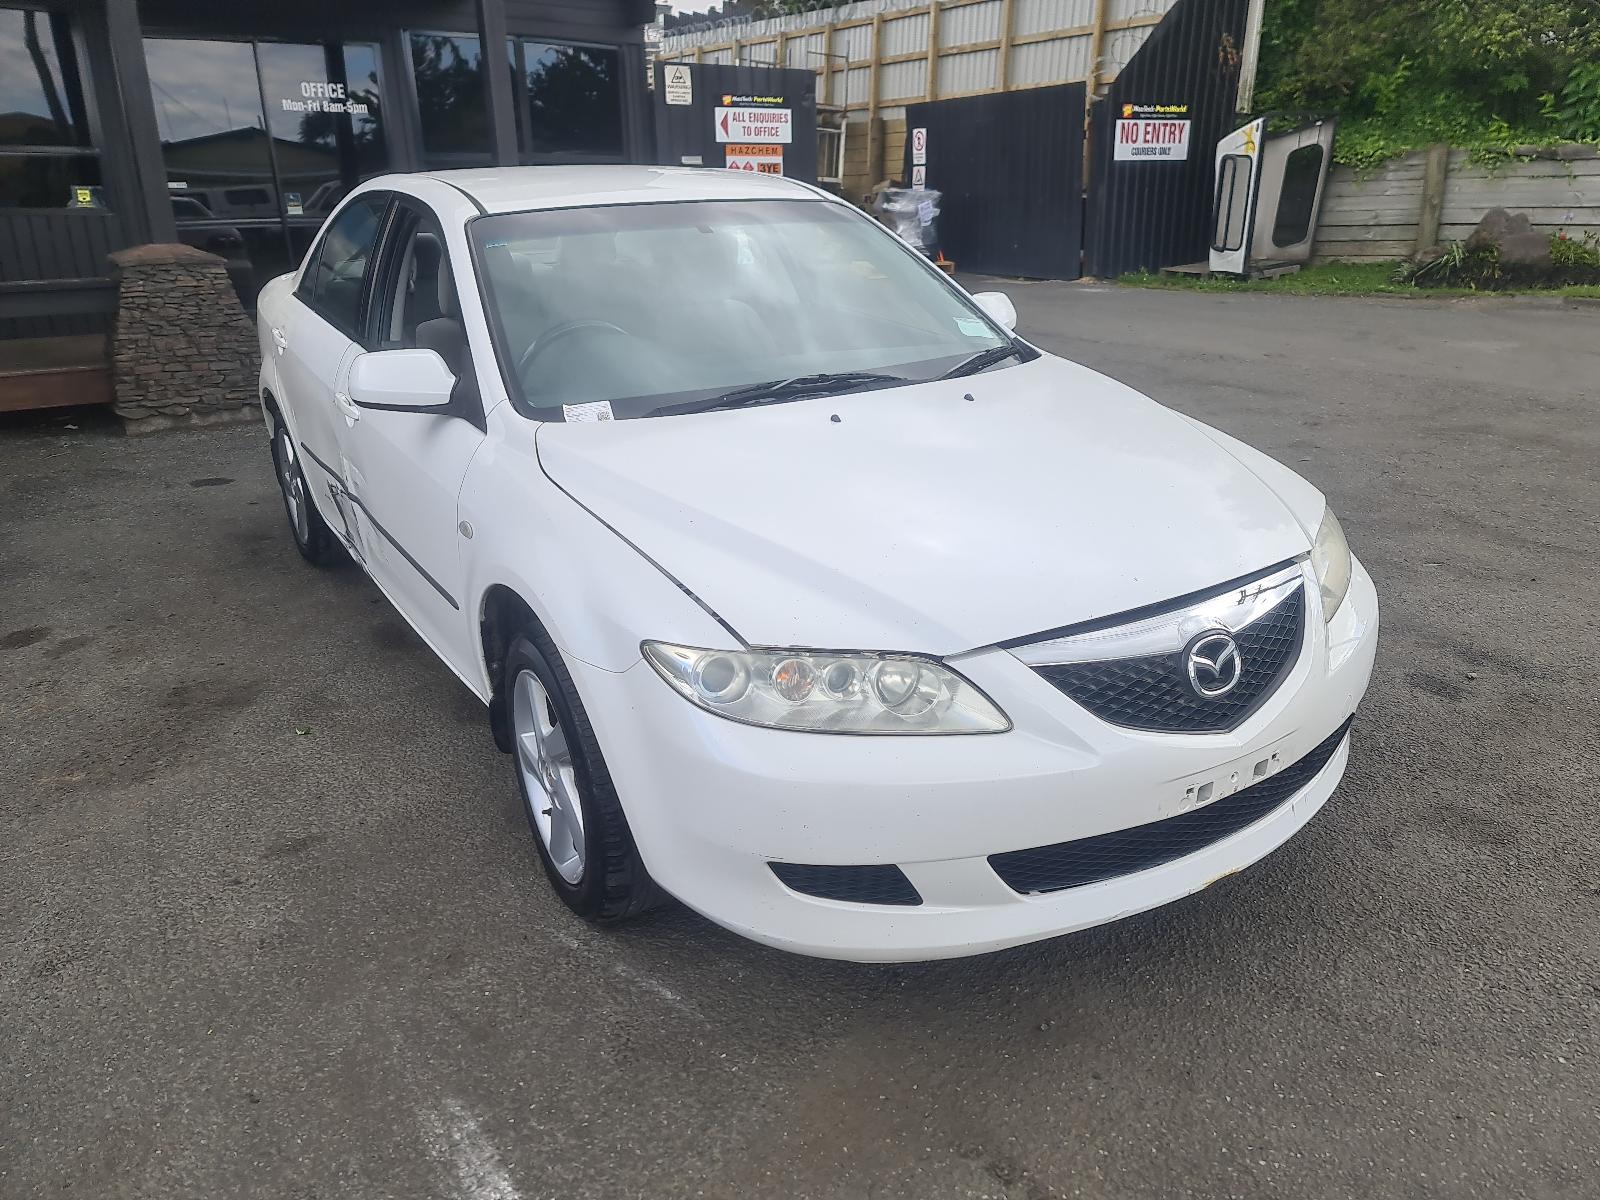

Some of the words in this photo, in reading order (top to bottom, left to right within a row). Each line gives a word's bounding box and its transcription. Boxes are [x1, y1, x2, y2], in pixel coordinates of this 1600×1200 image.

[301, 82, 345, 98] OFFICE
[282, 99, 320, 112] Mon-Fri
[323, 100, 368, 114] 8am-5pm
[732, 111, 746, 122] ALL
[748, 112, 789, 124] ENQUIRIES
[742, 126, 751, 136] TO
[754, 126, 780, 137] OFFICE
[1120, 122, 1139, 144] NO
[1143, 122, 1185, 144] ENTRY
[731, 146, 778, 155] HAZCHEM
[1131, 146, 1157, 156] COURIERS
[1158, 146, 1172, 156] ONLY
[760, 163, 779, 173] 3YE
